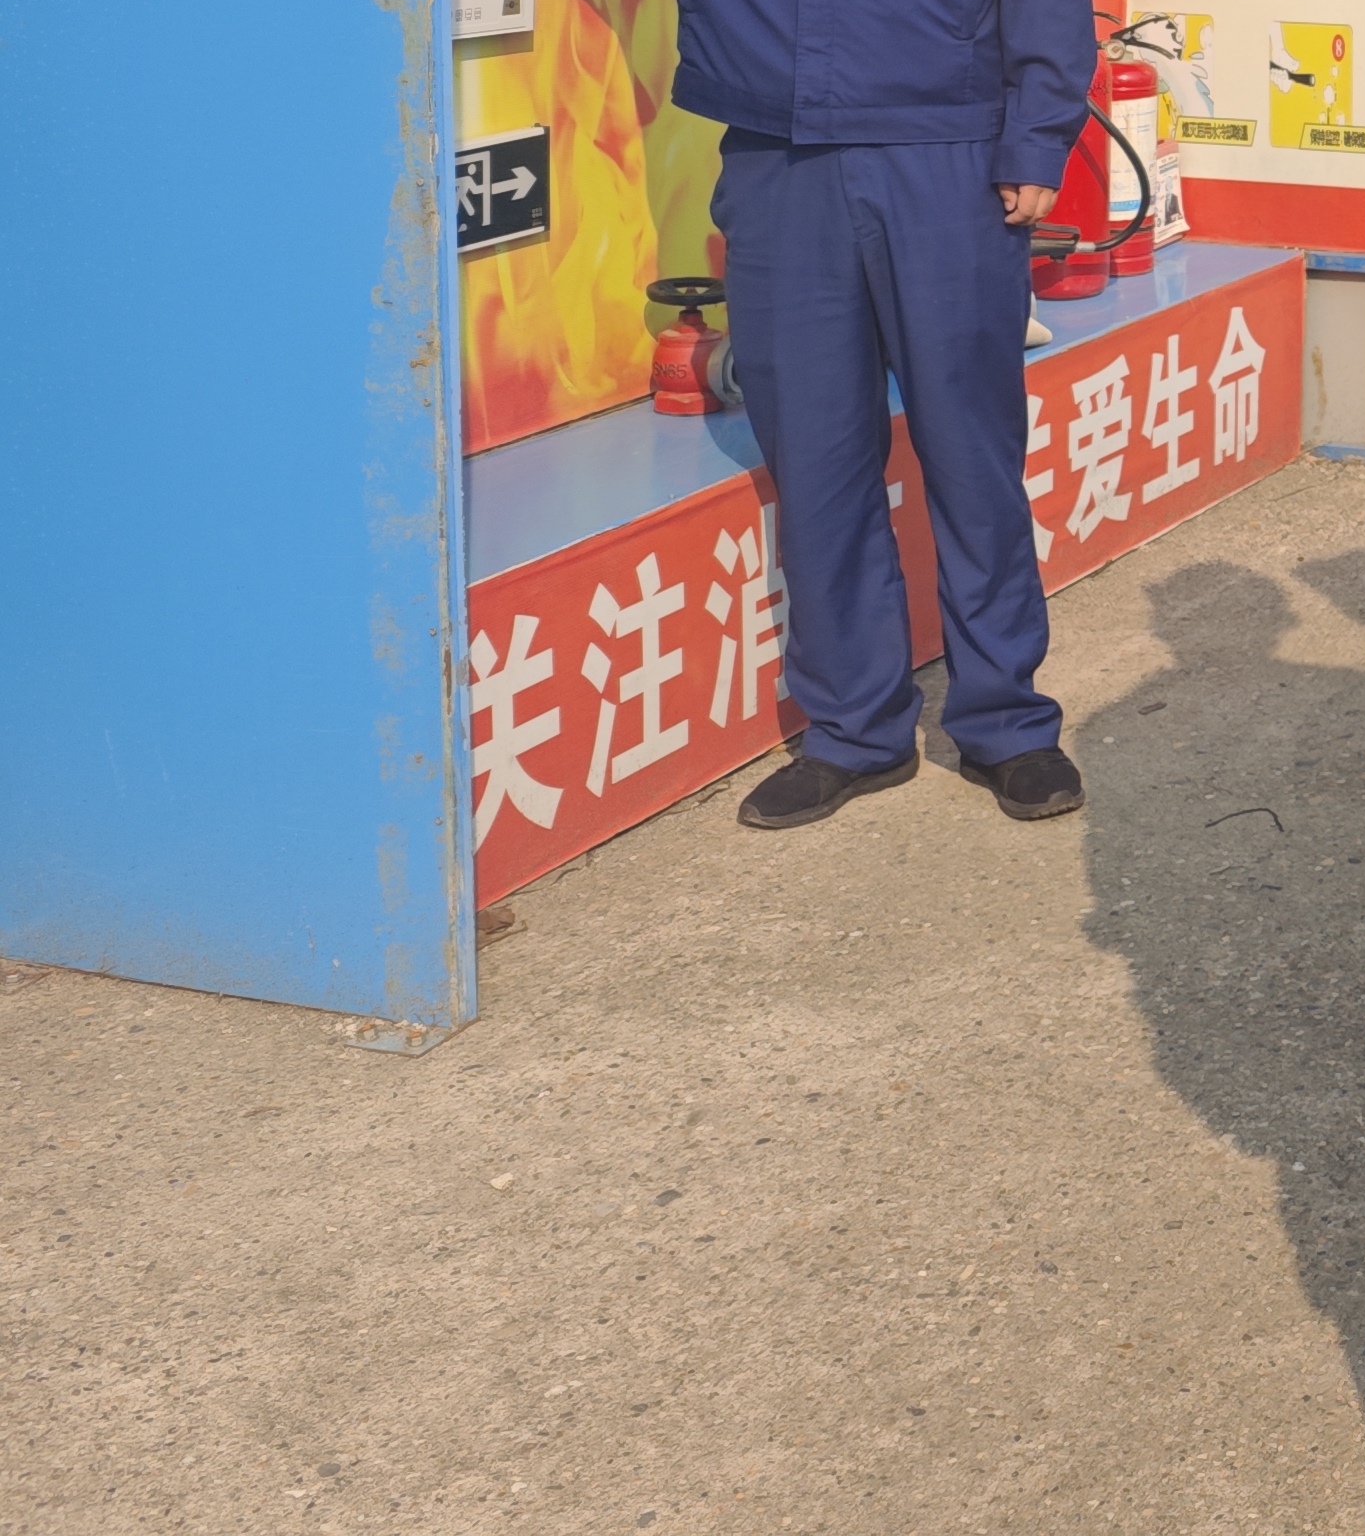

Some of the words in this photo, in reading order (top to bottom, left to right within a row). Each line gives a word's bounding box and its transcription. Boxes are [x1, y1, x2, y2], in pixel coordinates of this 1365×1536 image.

[653, 361, 687, 379] SN65
[470, 481, 903, 856] 关注消
